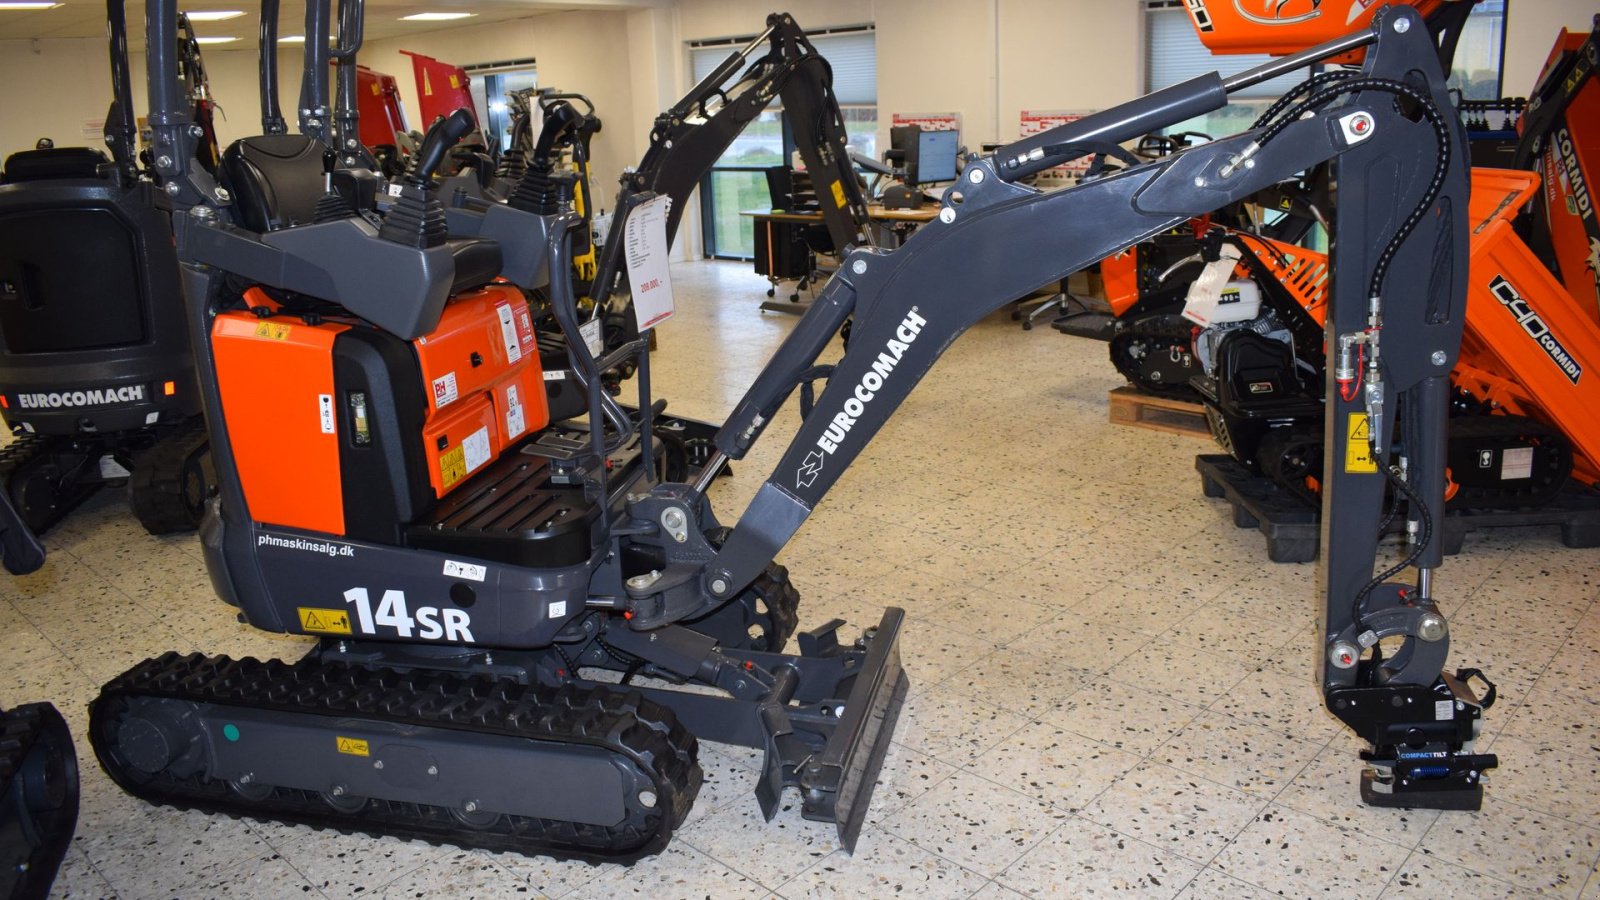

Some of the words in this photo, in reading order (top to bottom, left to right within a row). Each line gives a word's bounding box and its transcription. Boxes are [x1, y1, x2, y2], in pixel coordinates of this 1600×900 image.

[1558, 128, 1593, 220] CORMIDI
[1490, 280, 1549, 339] C40
[1540, 334, 1581, 379] CORMIDI
[18, 385, 143, 409] EUROCOMACH
[816, 309, 928, 455] EUROCOMACH
[258, 534, 354, 557] phmaskinsalg.dk
